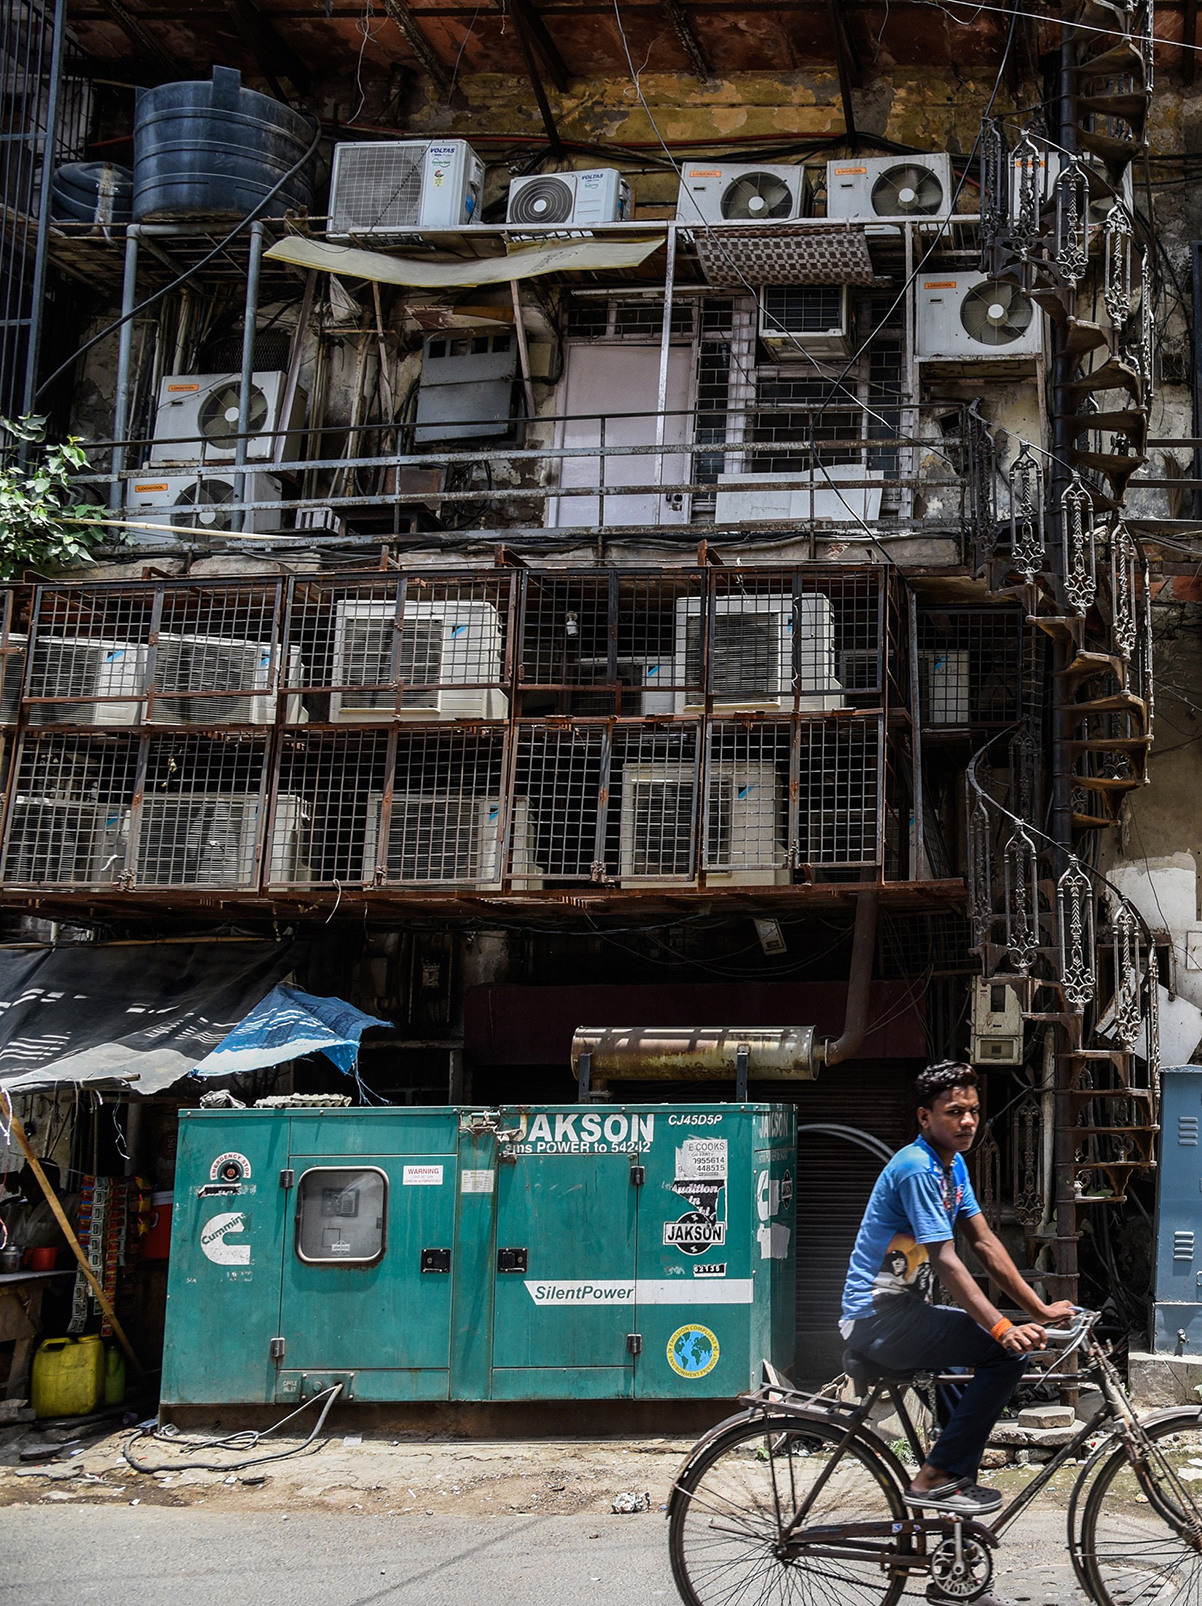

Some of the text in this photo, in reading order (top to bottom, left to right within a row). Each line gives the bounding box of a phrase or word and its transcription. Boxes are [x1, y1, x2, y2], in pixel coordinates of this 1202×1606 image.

[668, 1114, 723, 1126] CJ45D5P
[537, 1142, 590, 1154] POWER
[593, 1142, 607, 1153] to
[611, 1141, 651, 1153] 54242
[695, 1142, 725, 1151] COOKS
[211, 1153, 250, 1179] EMERGENCY STOP
[407, 1167, 440, 1175] WARNING
[671, 1183, 719, 1194] Audition
[668, 1225, 722, 1241] JAKSON
[535, 1285, 634, 1300] SilentPower
[669, 1325, 718, 1347] EMISSION COMPLIANT
[669, 1356, 700, 1377] ENVIRONMENT
